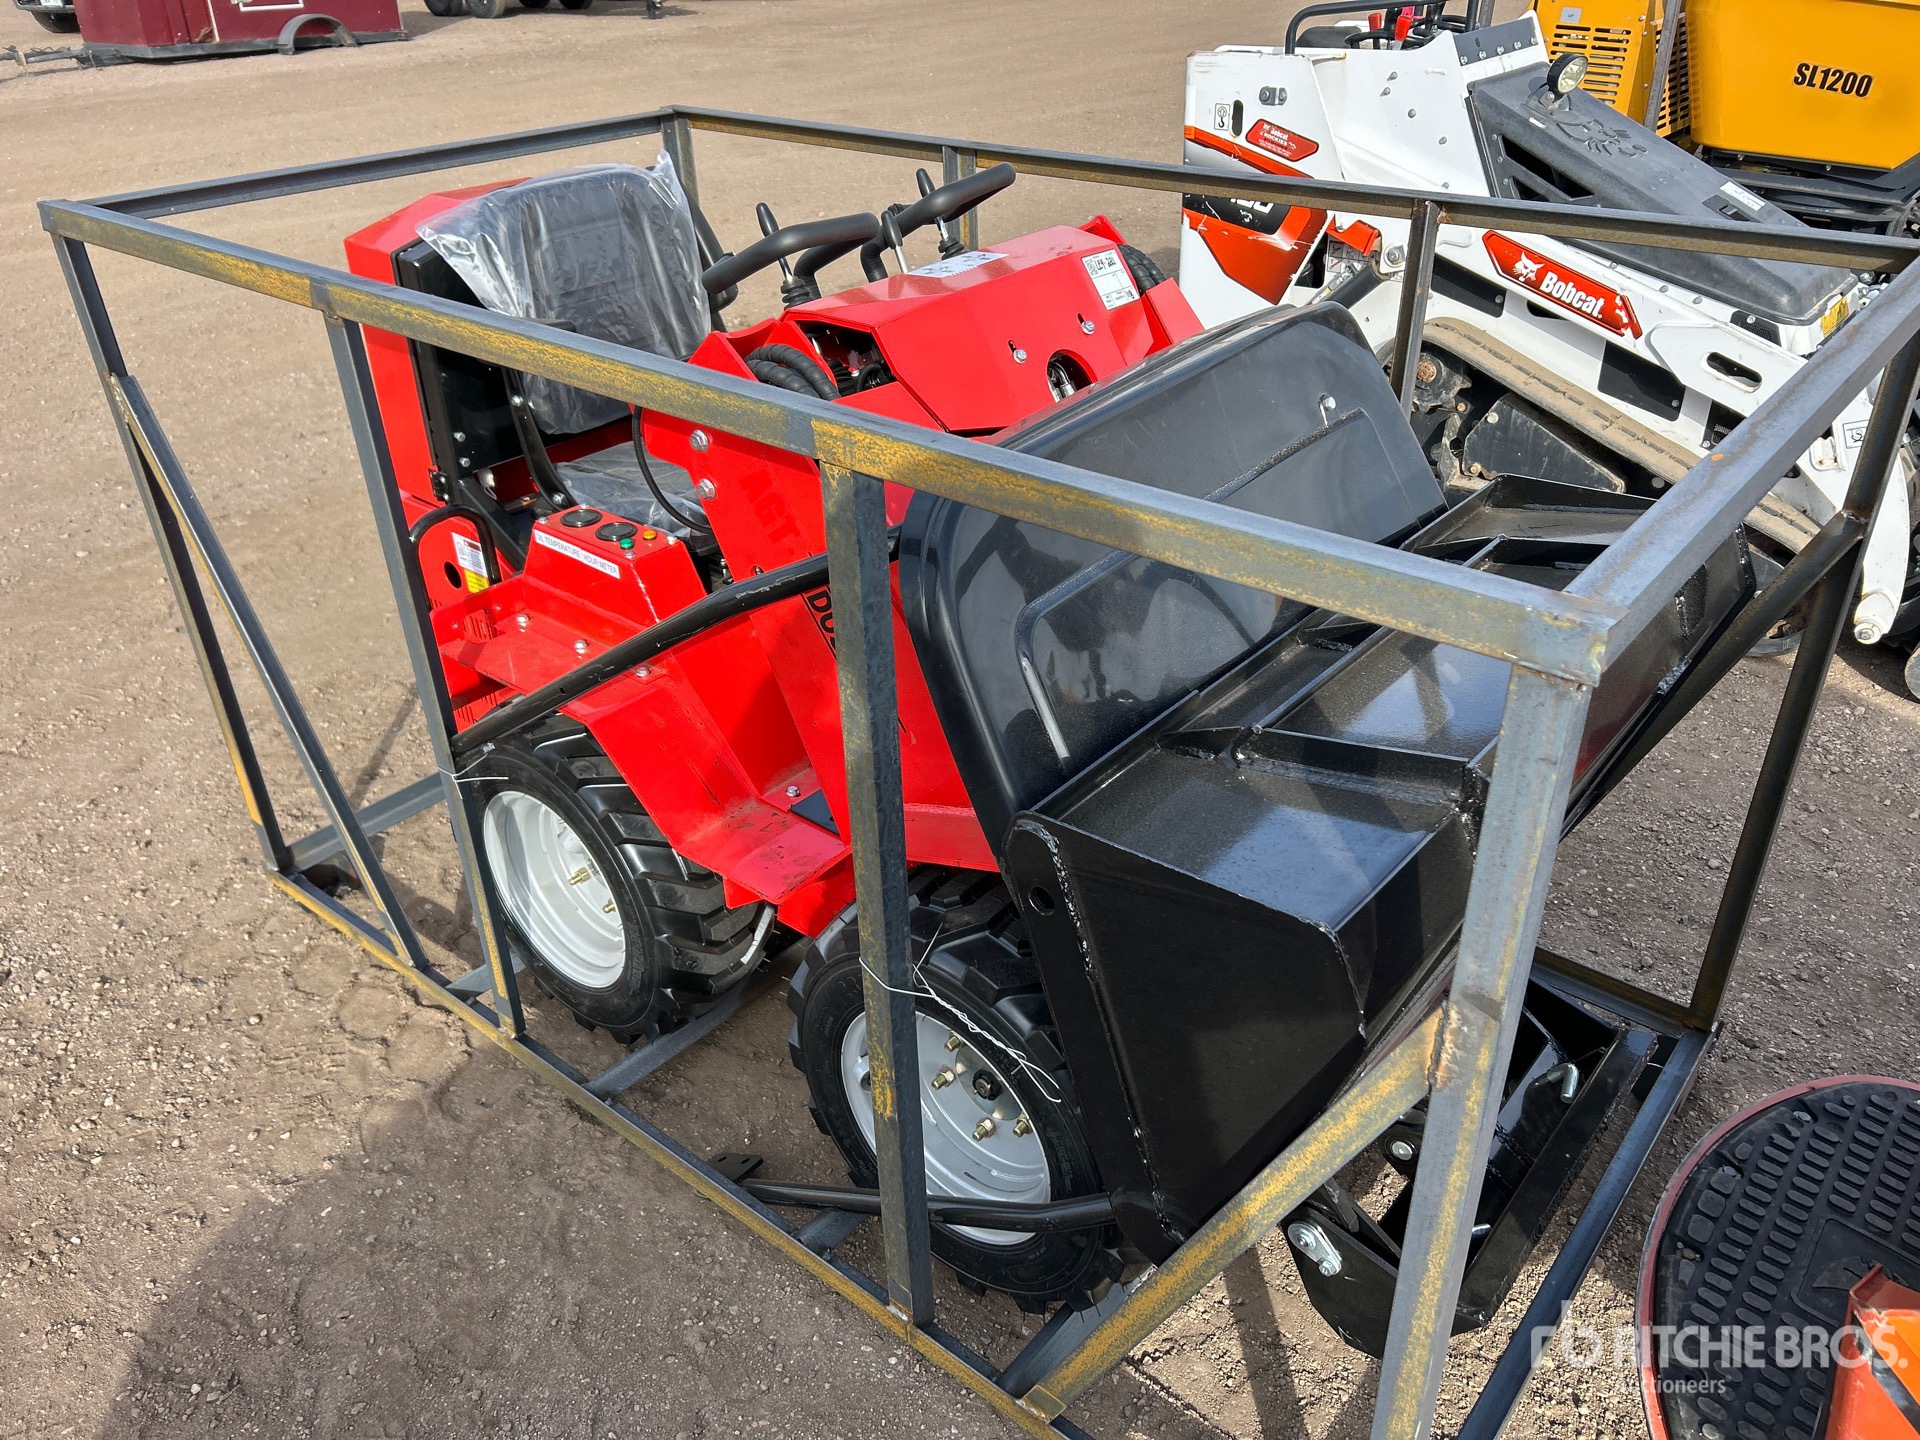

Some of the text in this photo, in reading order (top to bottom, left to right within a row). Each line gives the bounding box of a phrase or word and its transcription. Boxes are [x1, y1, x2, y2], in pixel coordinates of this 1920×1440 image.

[1793, 62, 1873, 97] SL1200
[1540, 271, 1605, 318] Bobcat
[739, 468, 801, 544] AGT
[545, 536, 581, 558] TEMPERATURE
[583, 553, 618, 575] HOUR METER
